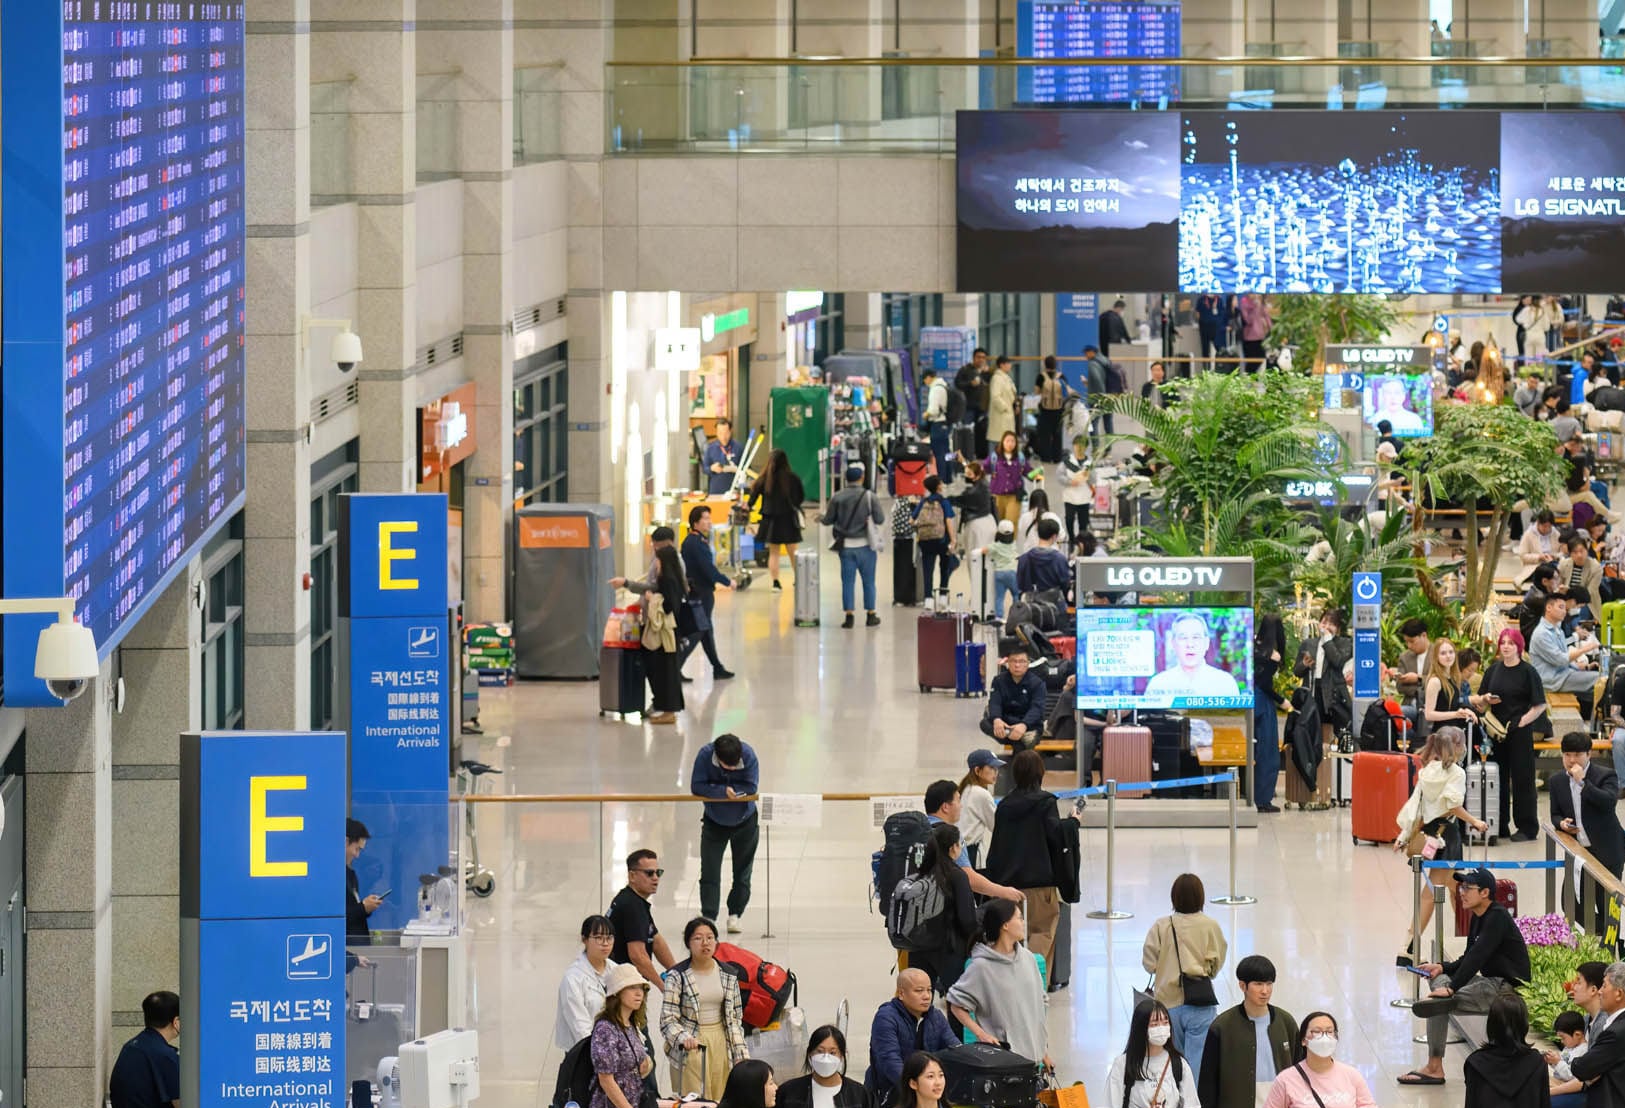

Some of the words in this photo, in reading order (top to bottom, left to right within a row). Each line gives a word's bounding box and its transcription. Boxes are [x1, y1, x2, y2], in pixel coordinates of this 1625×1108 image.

[1015, 178, 1065, 193] 세탁에서
[1548, 176, 1586, 192] 새로운
[1015, 198, 1051, 213] 하나의
[1055, 198, 1079, 213] 도어
[1083, 198, 1119, 213] 안에서
[1515, 199, 1539, 216] LG
[379, 521, 419, 590] E
[1107, 567, 1135, 586] LG
[1139, 567, 1193, 586] OLED
[1193, 567, 1222, 586] TV
[371, 670, 439, 687] 국제선도착
[1186, 696, 1253, 706] 080-536-7777
[388, 708, 439, 721] 国际线到达
[366, 724, 440, 738] International
[397, 736, 440, 749] Arrivals
[250, 775, 308, 878] E
[230, 999, 332, 1024] 국제선도착
[255, 1032, 332, 1051] 国際線到着
[255, 1056, 331, 1074] 国际线到达
[221, 1079, 332, 1099] International
